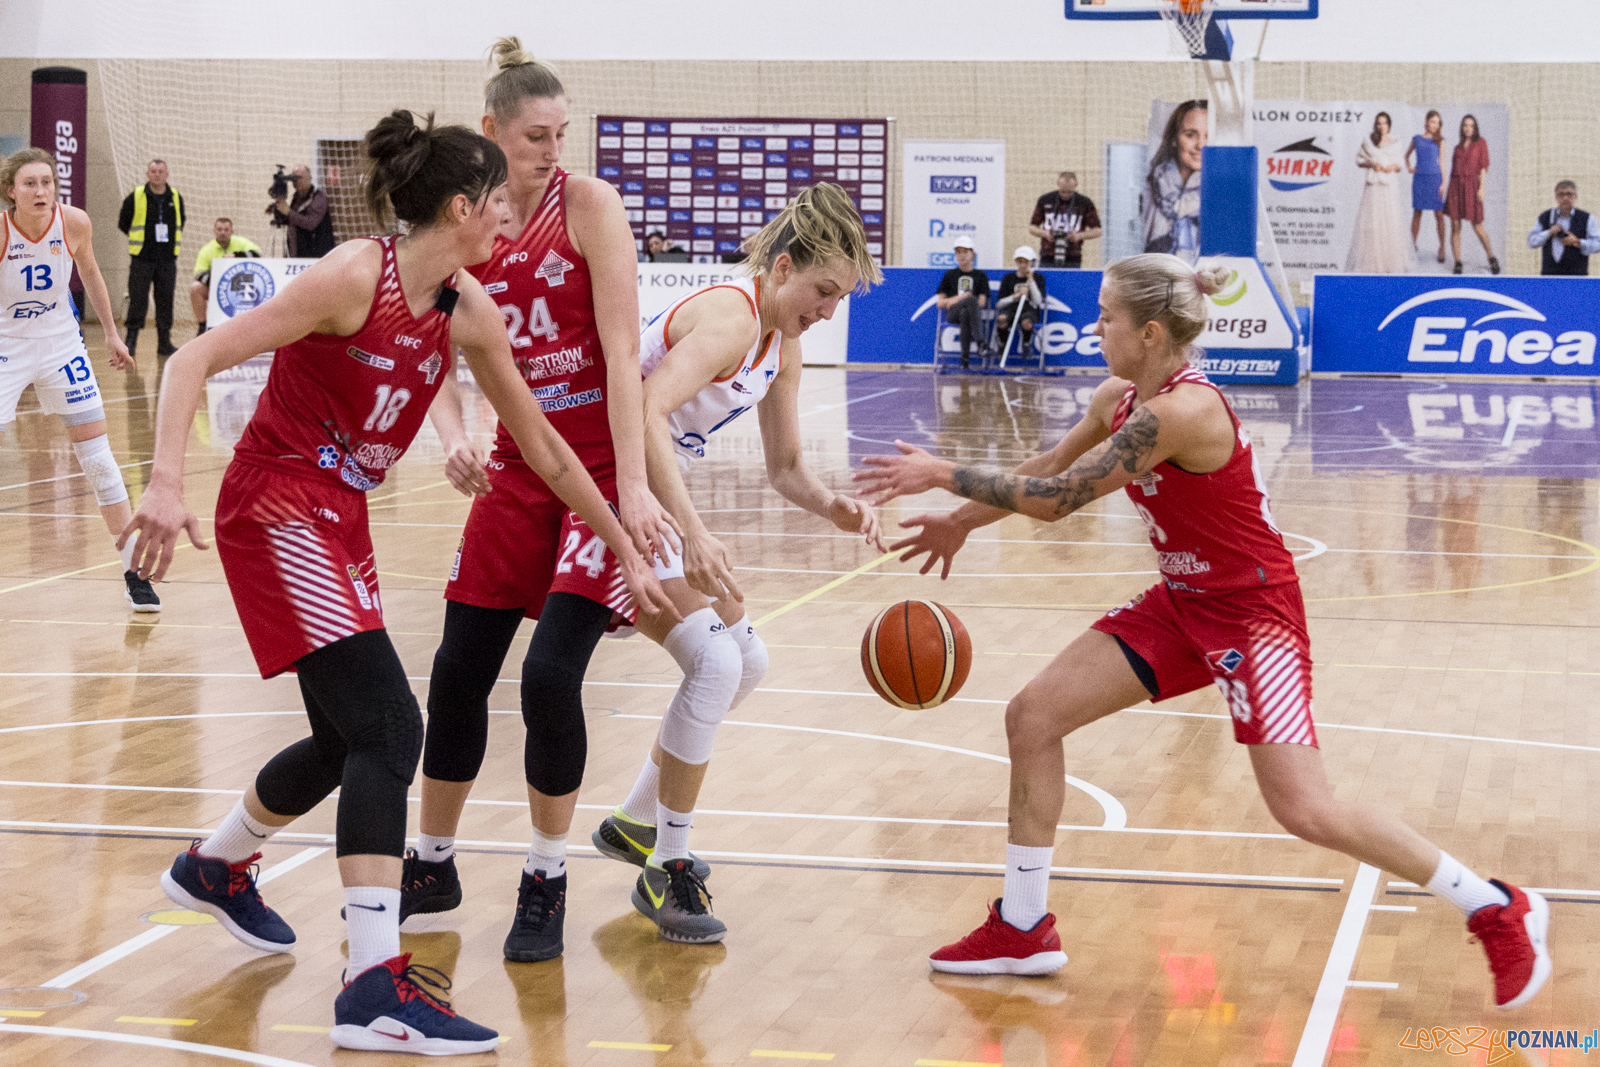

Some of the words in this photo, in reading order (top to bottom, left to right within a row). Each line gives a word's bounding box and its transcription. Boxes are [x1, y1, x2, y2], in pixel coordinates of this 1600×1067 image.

[1296, 109, 1363, 122] ODZIEŻY
[1266, 157, 1334, 177] SHARK
[20, 264, 53, 292] 13
[500, 296, 560, 349] 24
[1407, 316, 1597, 365] Enea
[58, 356, 91, 386] 13
[528, 346, 583, 370] OSTRÓW
[530, 356, 594, 381] WIELKOPOLSKI
[531, 383, 570, 399] OWIAT
[362, 384, 412, 433] 18
[557, 529, 606, 579] 24
